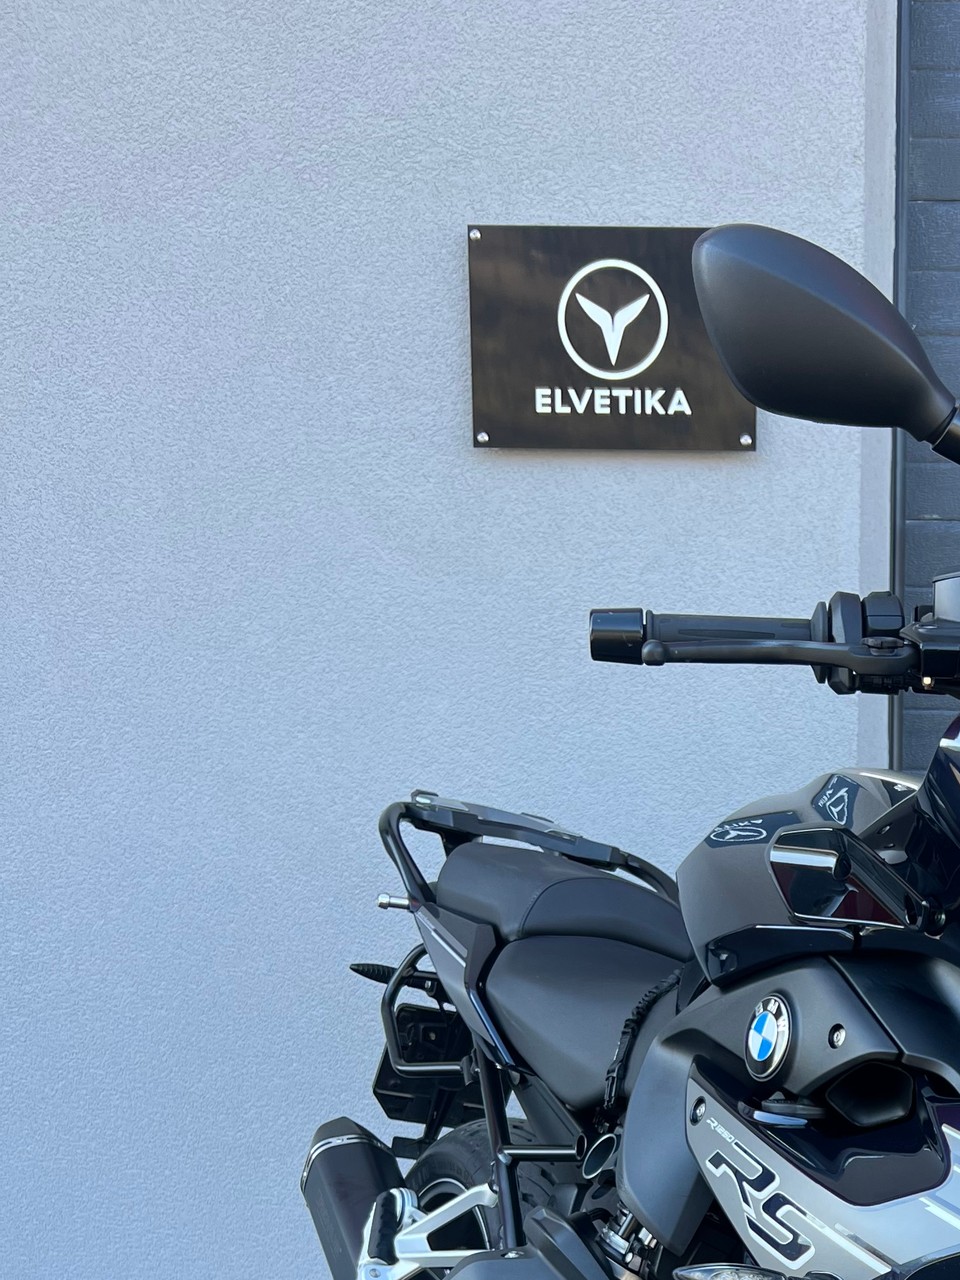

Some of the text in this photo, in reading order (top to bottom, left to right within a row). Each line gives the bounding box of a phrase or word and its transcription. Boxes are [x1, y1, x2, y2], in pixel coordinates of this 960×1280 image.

[534, 386, 693, 416] ELVETIKA
[754, 999, 788, 1032] BMW
[706, 1139, 815, 1270] RS
